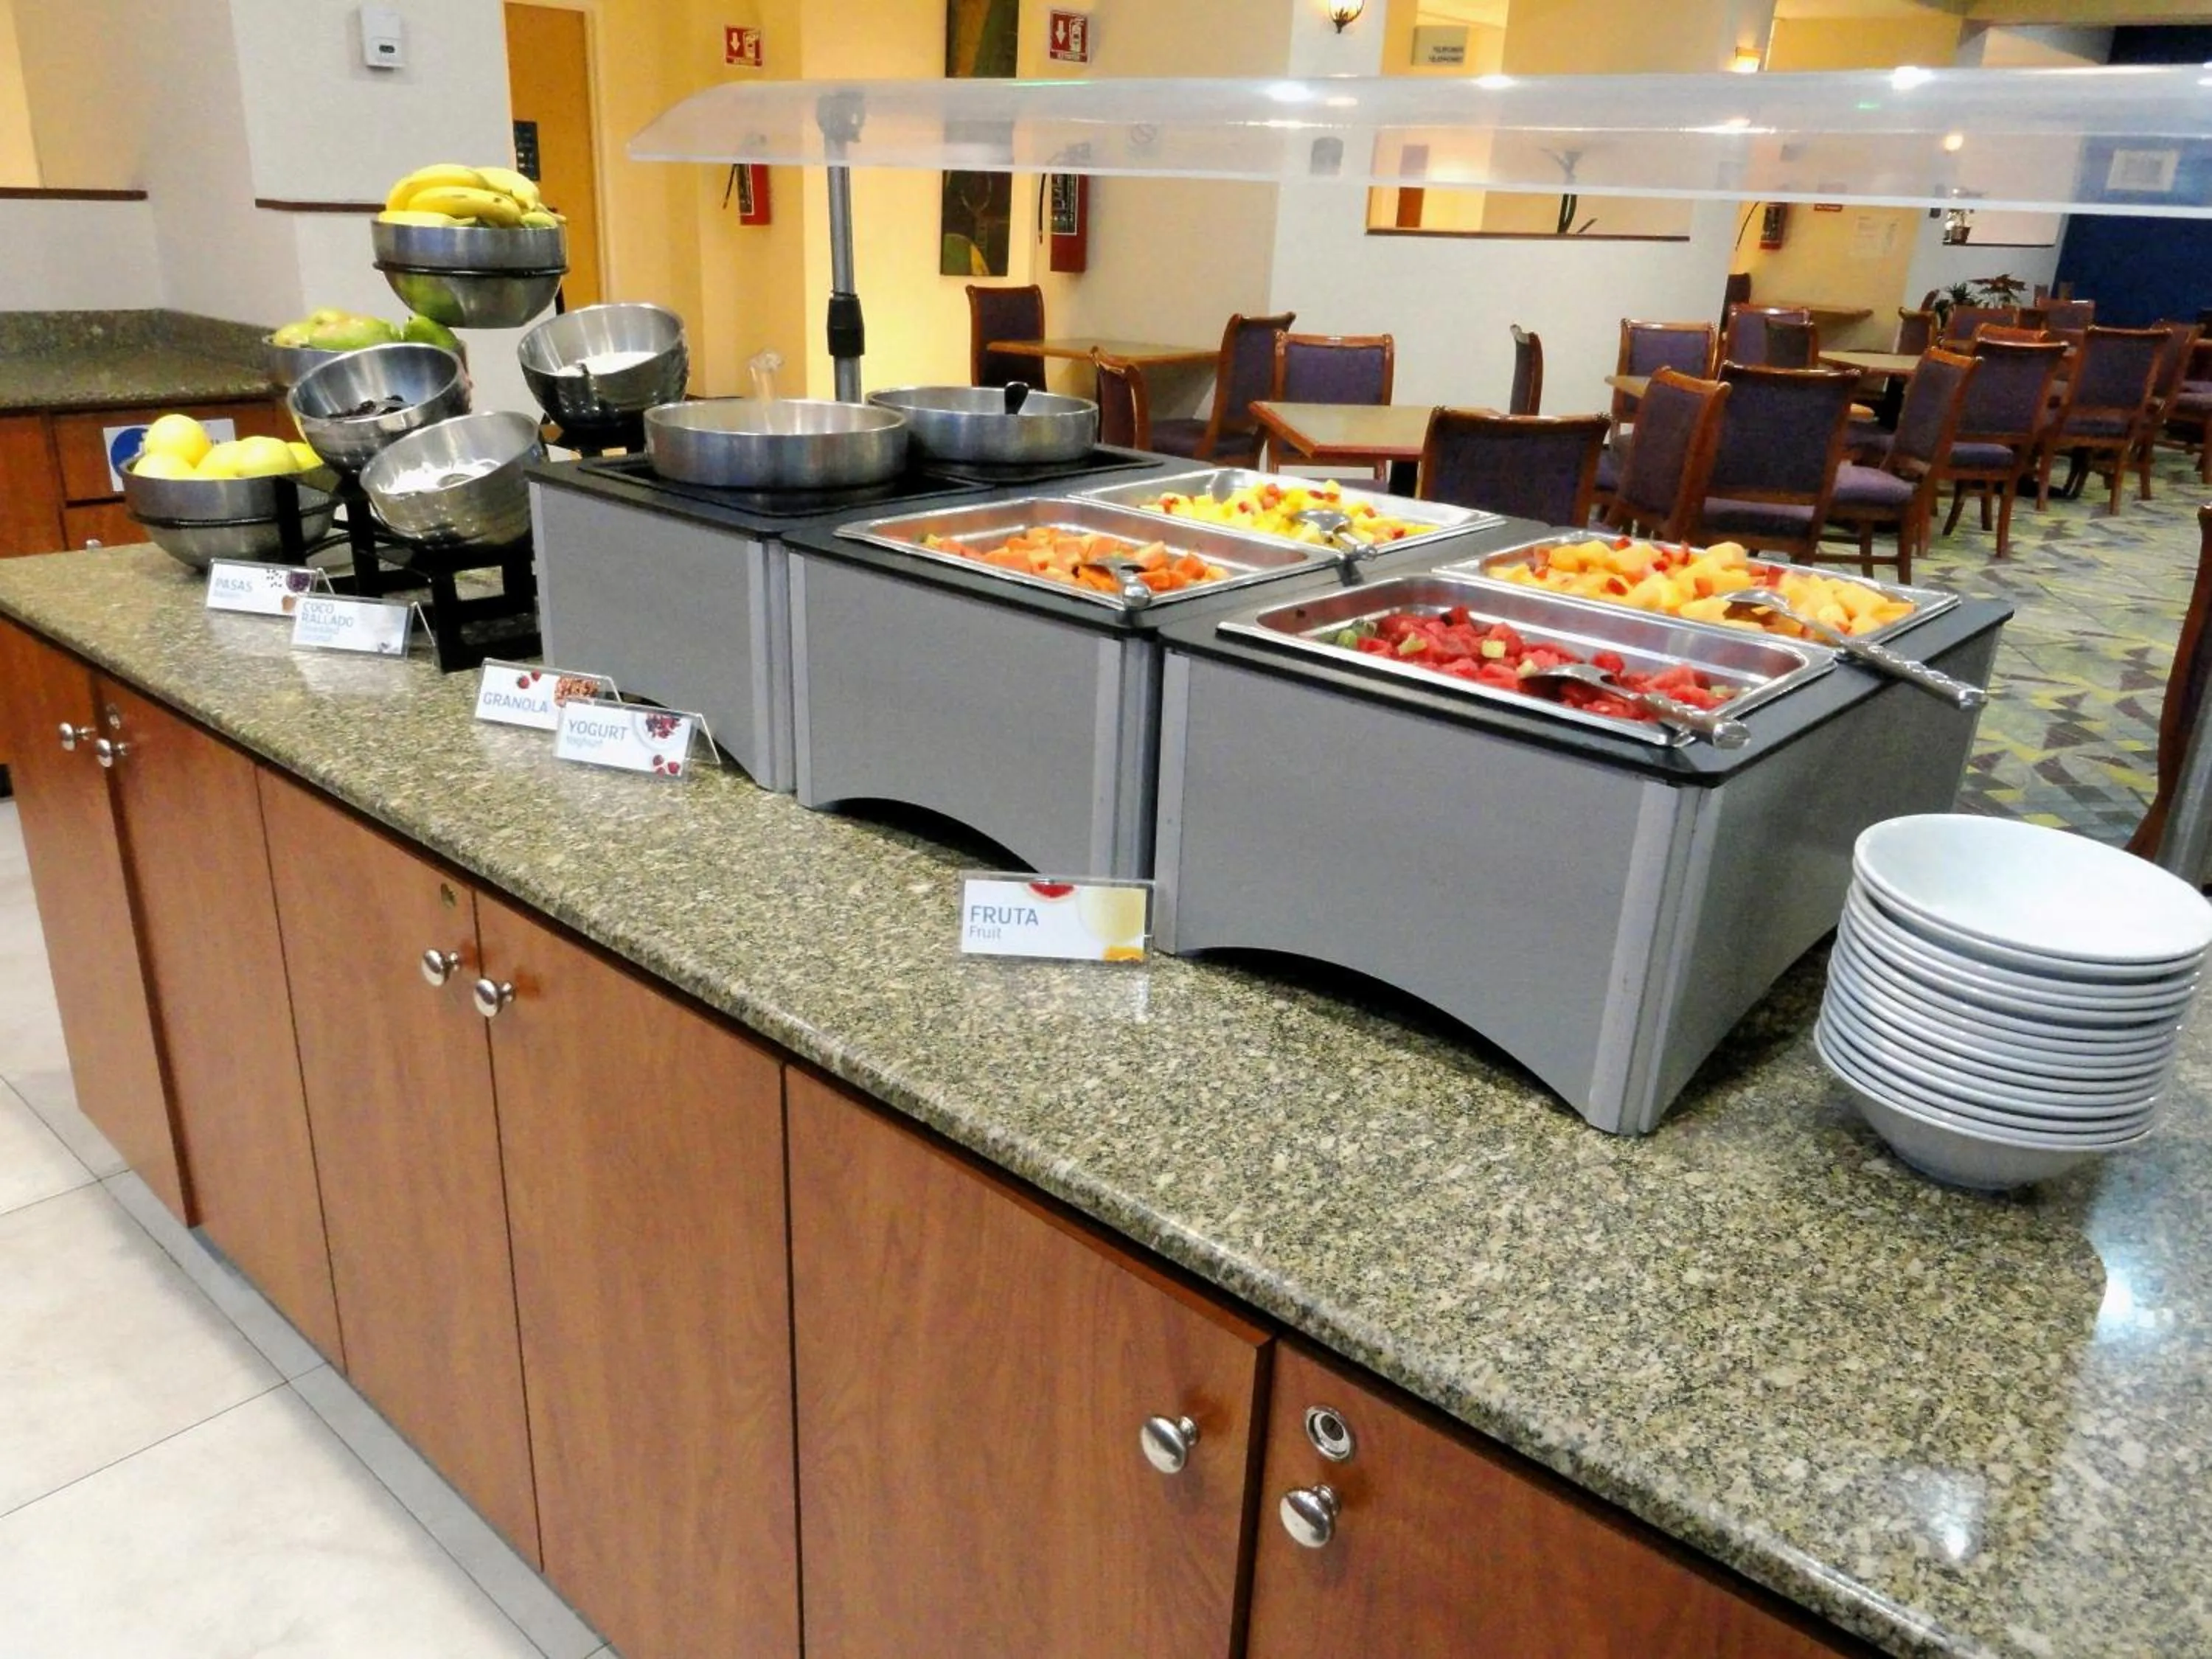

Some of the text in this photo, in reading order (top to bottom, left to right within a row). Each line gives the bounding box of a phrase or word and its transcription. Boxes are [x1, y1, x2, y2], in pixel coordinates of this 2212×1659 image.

[215, 577, 253, 593] PASAS
[483, 692, 549, 713] GRANOLA
[568, 719, 628, 740] YOGURT
[970, 905, 1039, 926] FRUTA
[969, 925, 1002, 940] Fruit
